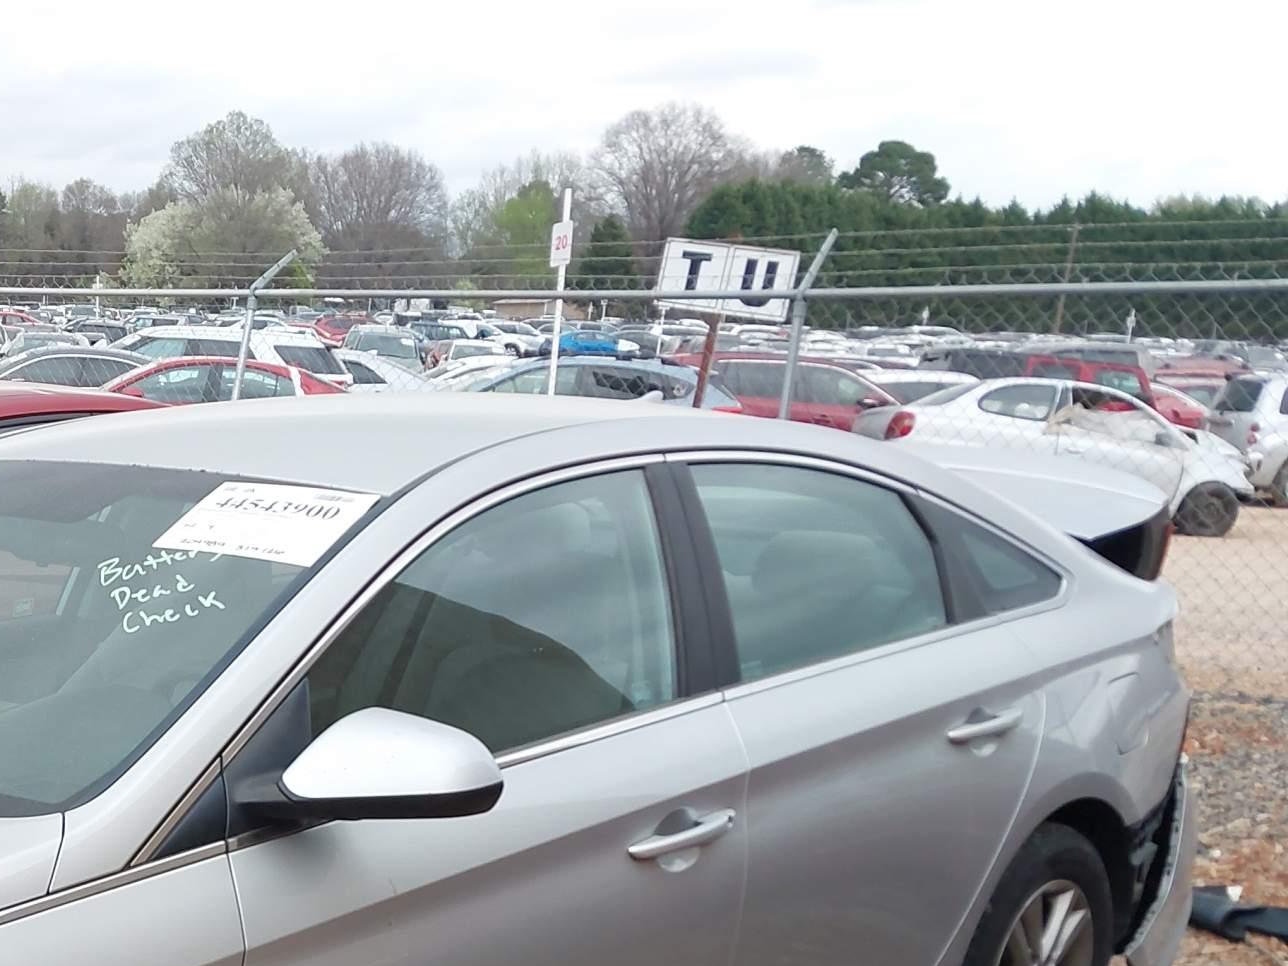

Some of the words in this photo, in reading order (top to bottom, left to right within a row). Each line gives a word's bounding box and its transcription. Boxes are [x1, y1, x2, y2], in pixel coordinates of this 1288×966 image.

[554, 234, 568, 251] 20
[682, 250, 713, 291] T
[740, 258, 780, 307] U
[215, 496, 342, 521] 44543900
[110, 574, 195, 610] Dead
[122, 591, 226, 633] Check
